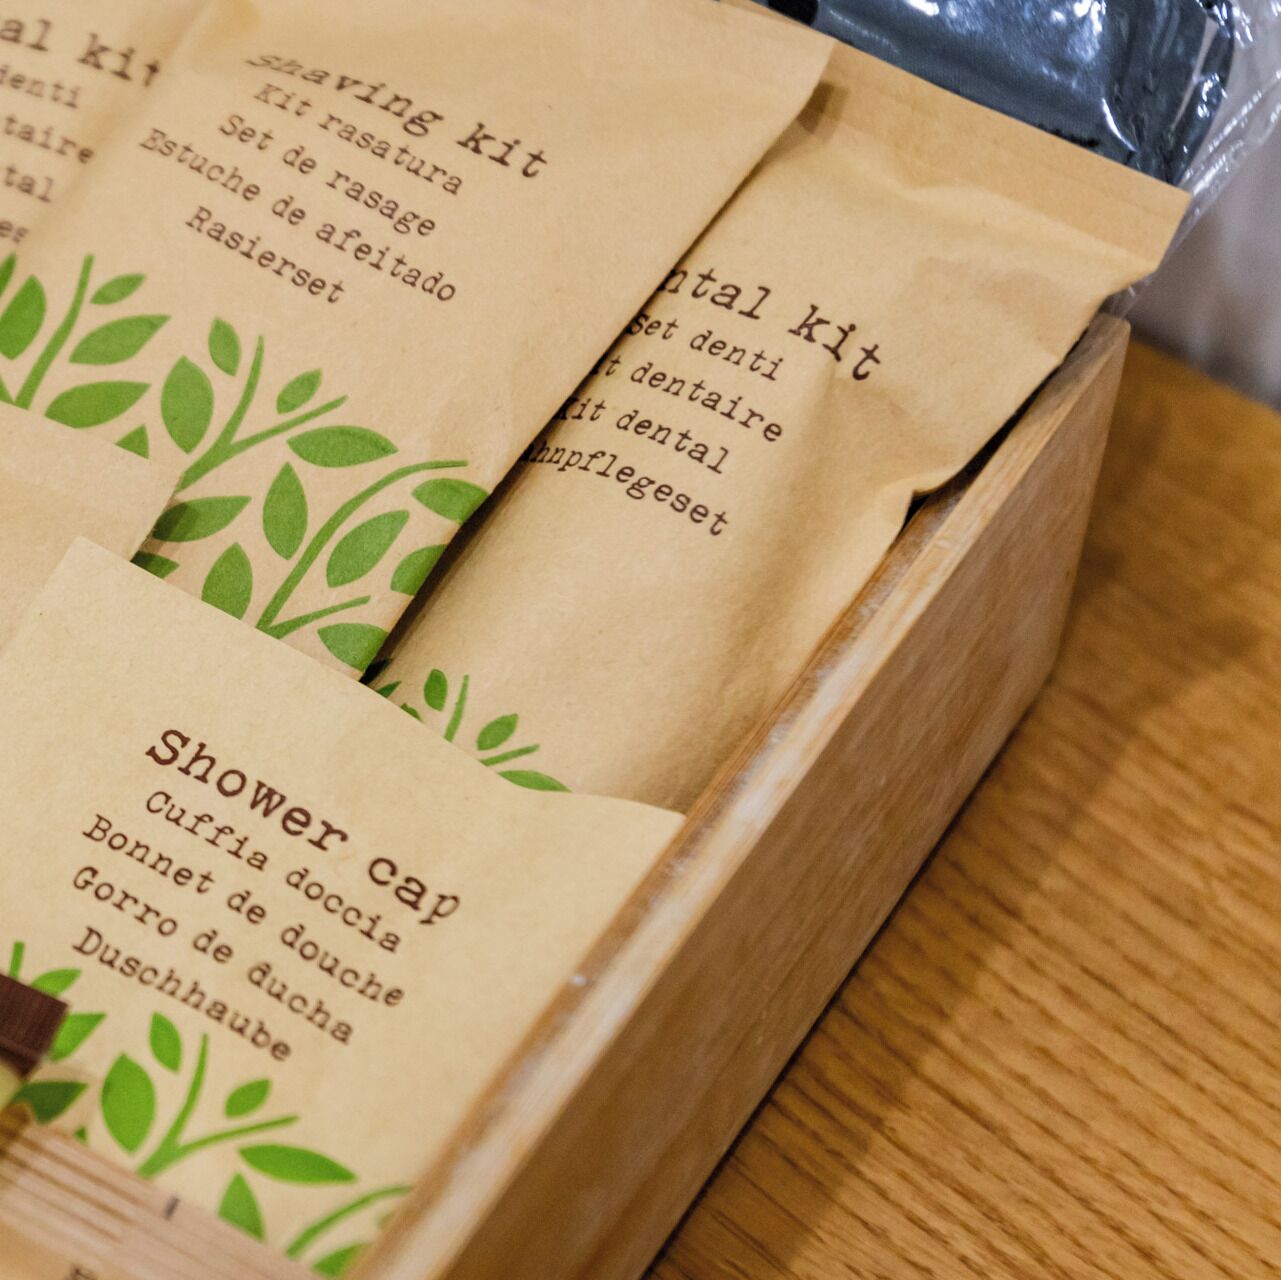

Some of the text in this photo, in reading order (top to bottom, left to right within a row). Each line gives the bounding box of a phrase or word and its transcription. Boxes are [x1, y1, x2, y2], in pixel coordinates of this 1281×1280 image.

[77, 33, 161, 86] kit
[219, 113, 436, 237] Set de rasage
[254, 83, 464, 195] Kit rasatura
[457, 123, 547, 178] kit
[138, 128, 456, 303] Estuche de afeitado
[185, 206, 346, 305] Rasierset
[690, 329, 785, 381] denti
[788, 304, 882, 381] kit
[616, 409, 730, 475] dental
[630, 361, 783, 443] dentaire
[145, 728, 461, 926] Shower cap
[145, 789, 401, 953] Cuffia doccia
[72, 865, 355, 1046] Gorro de ducha
[82, 814, 406, 1008] Bonnet de douche
[71, 926, 293, 1063] Duschhaube
